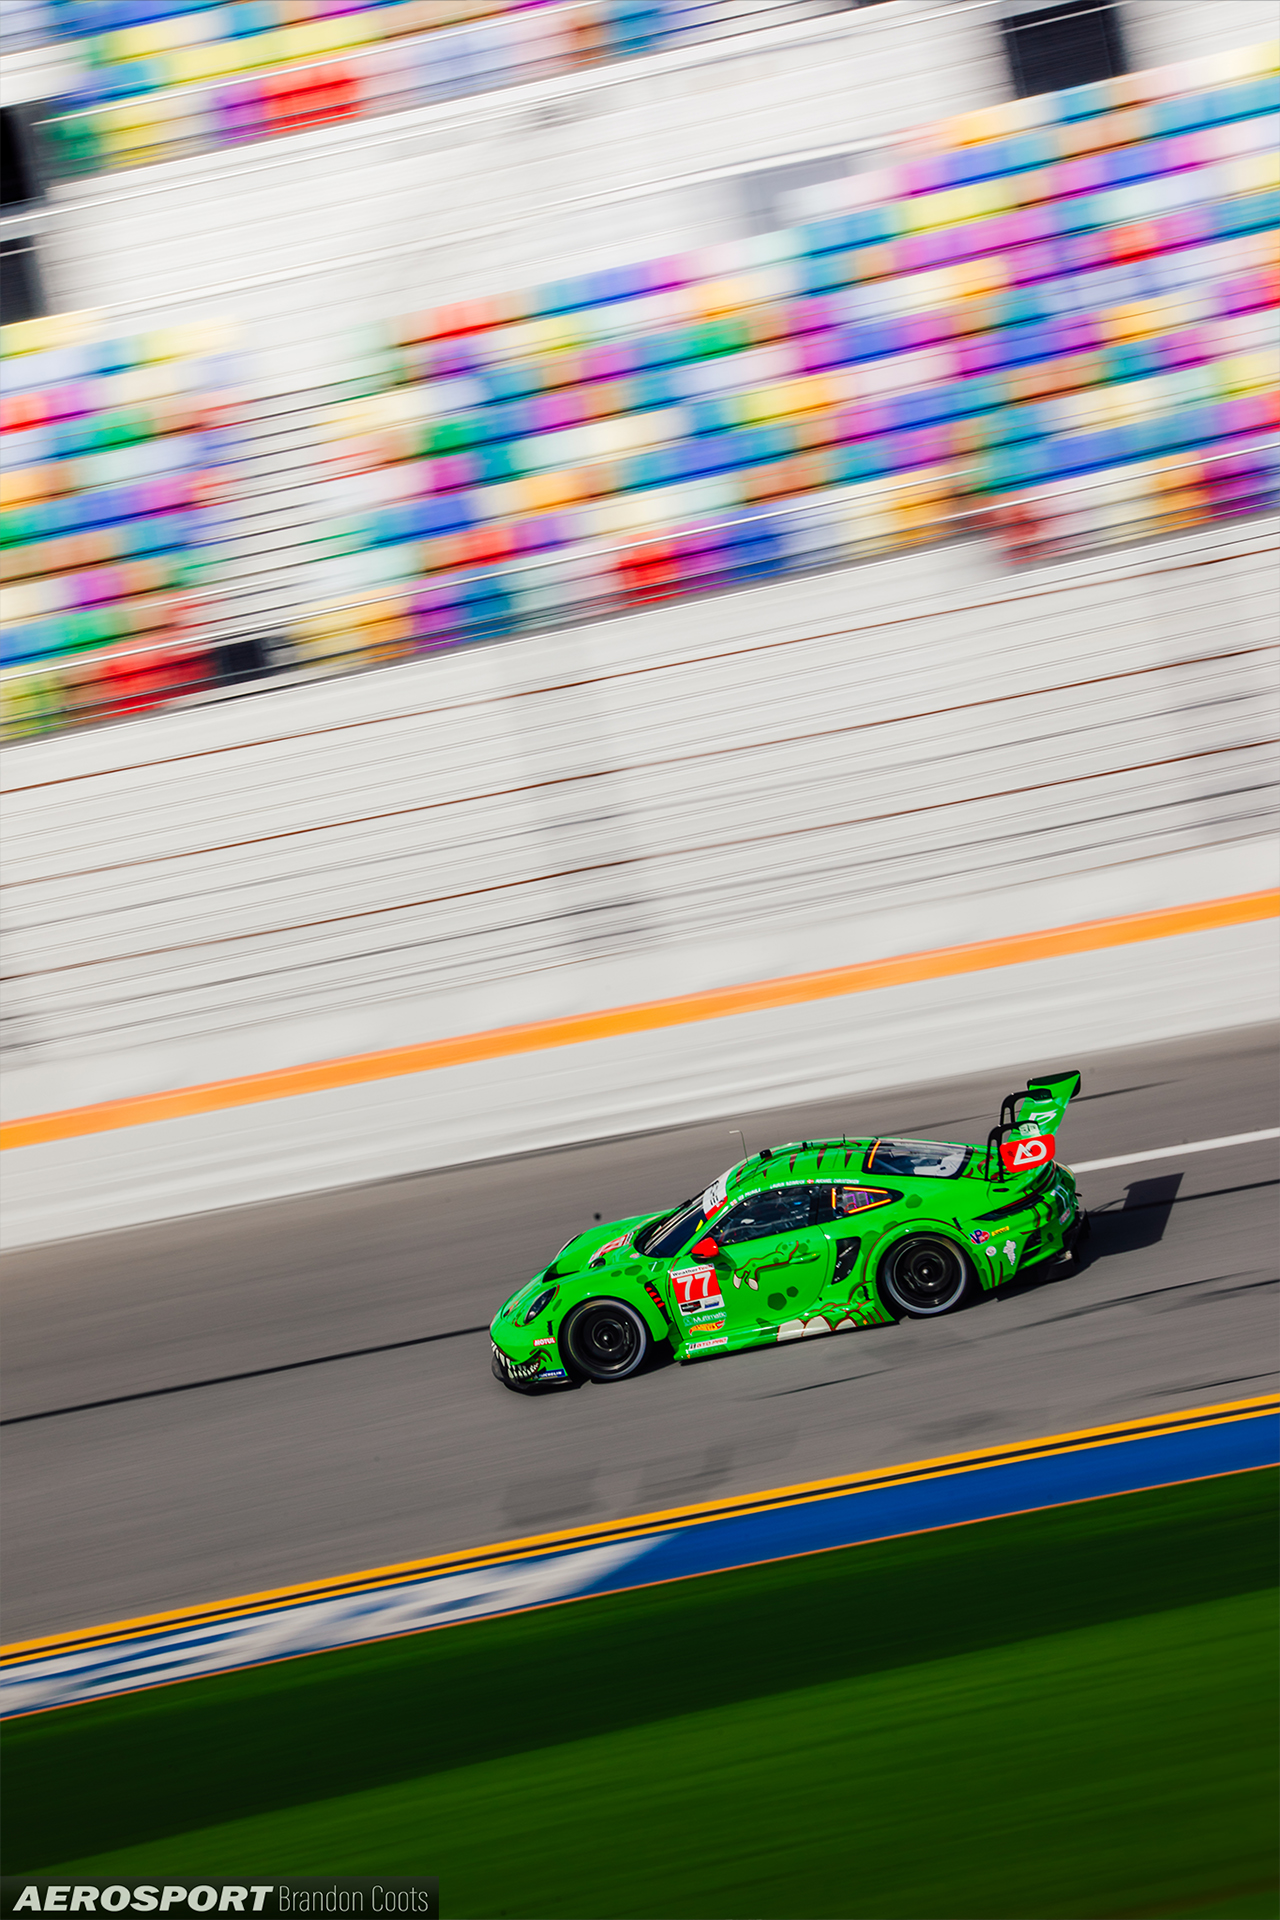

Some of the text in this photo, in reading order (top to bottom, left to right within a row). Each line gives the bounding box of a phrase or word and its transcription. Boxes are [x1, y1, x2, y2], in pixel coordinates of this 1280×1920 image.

[676, 1271, 711, 1301] 77
[692, 1311, 727, 1323] Multimatic
[534, 1337, 555, 1346] MOTUL
